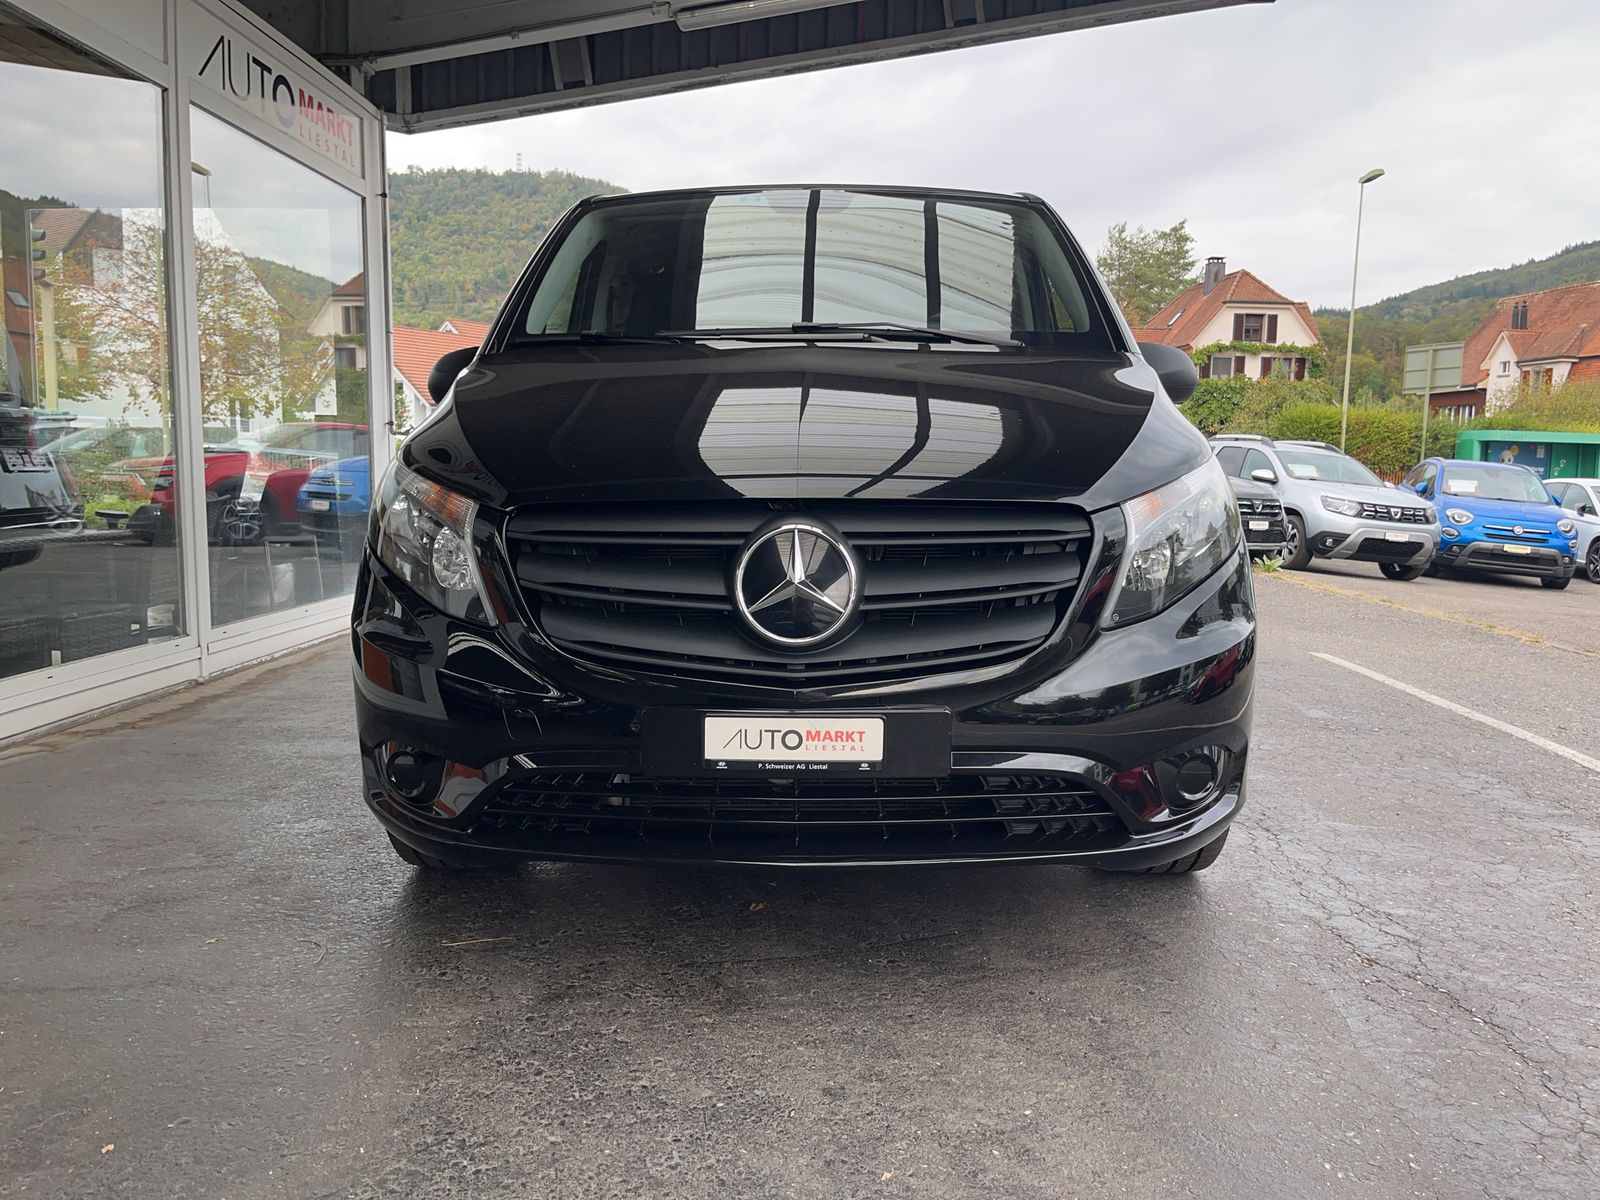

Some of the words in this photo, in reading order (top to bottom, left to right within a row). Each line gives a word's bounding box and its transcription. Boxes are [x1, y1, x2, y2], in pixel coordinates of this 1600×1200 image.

[198, 34, 295, 129] AUTO
[299, 87, 355, 148] MARKT
[299, 123, 356, 168] LIESTAL
[723, 728, 804, 751] AUTO
[805, 730, 866, 743] MARKT
[805, 744, 865, 752] LIESTAL
